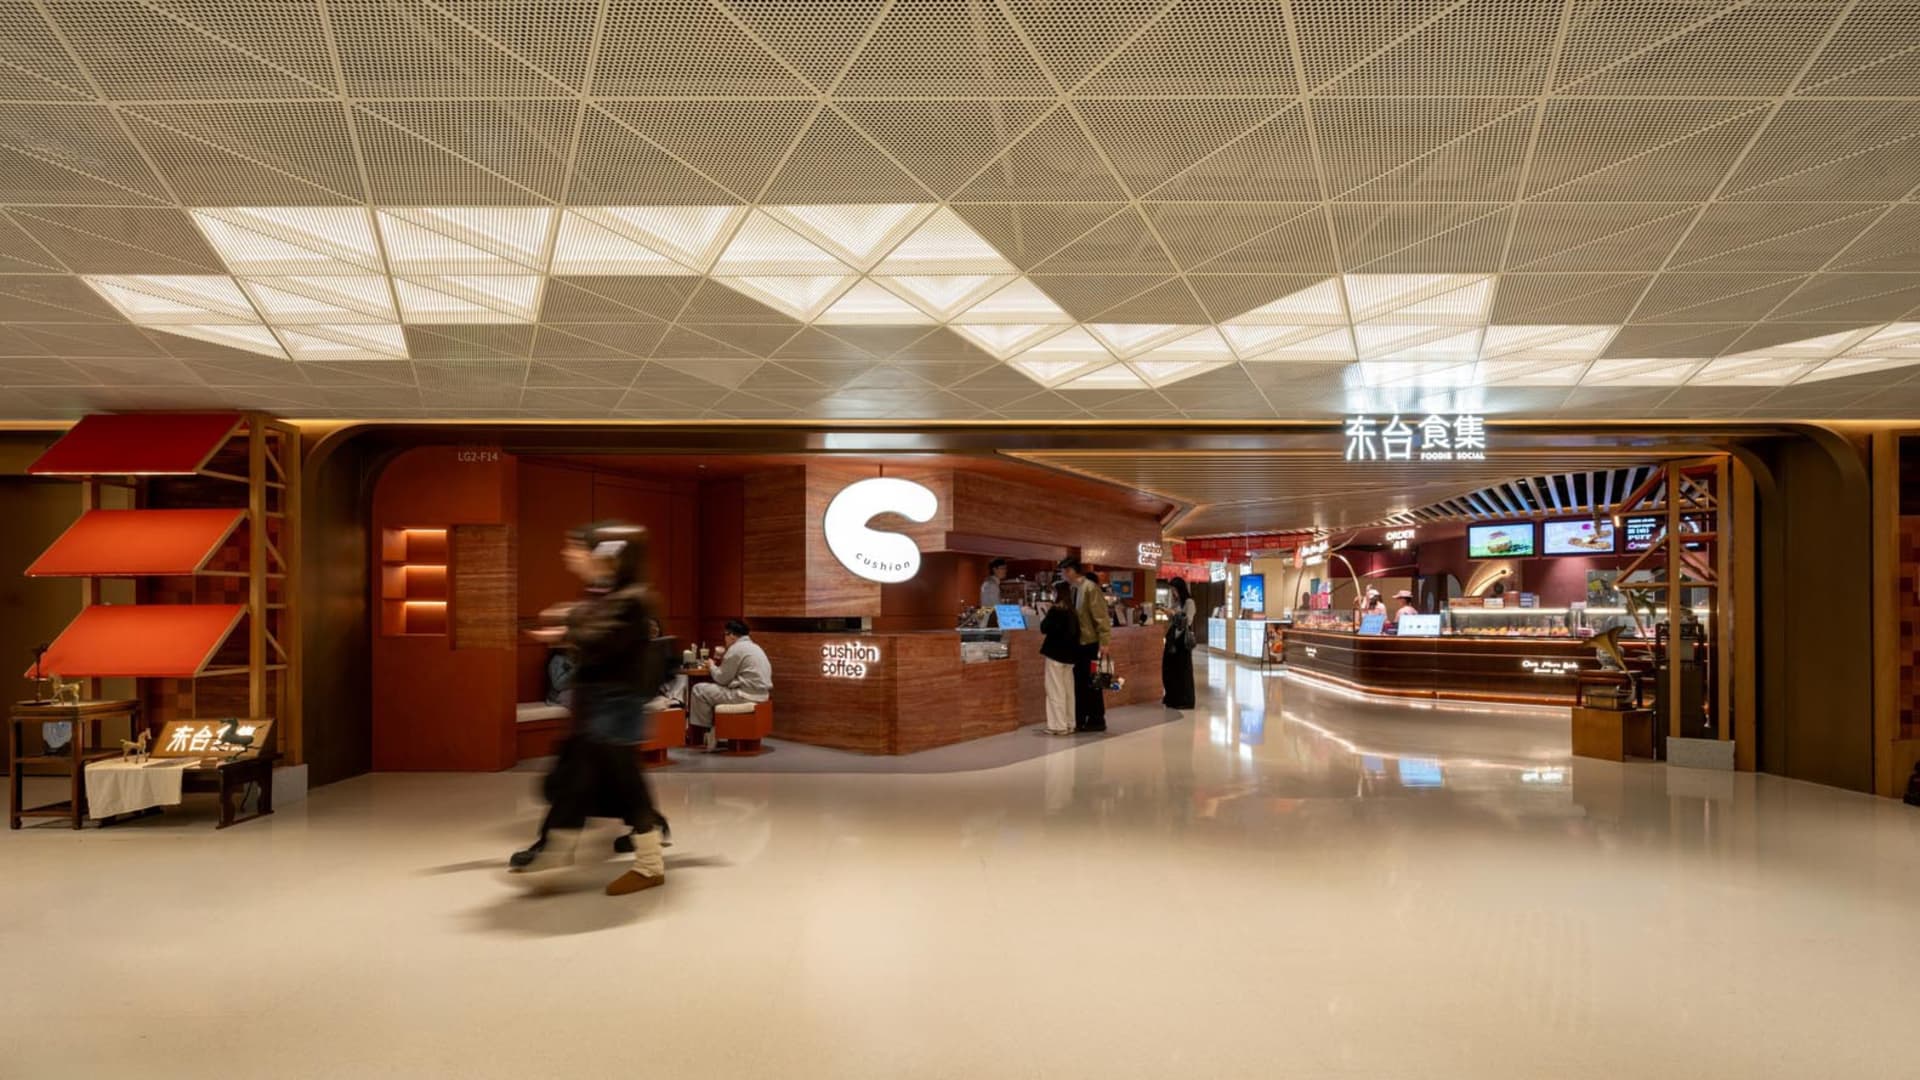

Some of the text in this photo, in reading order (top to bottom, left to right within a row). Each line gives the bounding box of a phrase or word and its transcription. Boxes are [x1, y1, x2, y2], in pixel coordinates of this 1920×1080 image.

[1345, 415, 1486, 460] 东台食集
[457, 451, 499, 462] LG2-F14
[1420, 452, 1486, 460] FOODIE SOCIAL
[1385, 529, 1416, 541] ORDER
[855, 552, 911, 571] cushion
[820, 641, 879, 661] cushion
[820, 660, 865, 677] coffee
